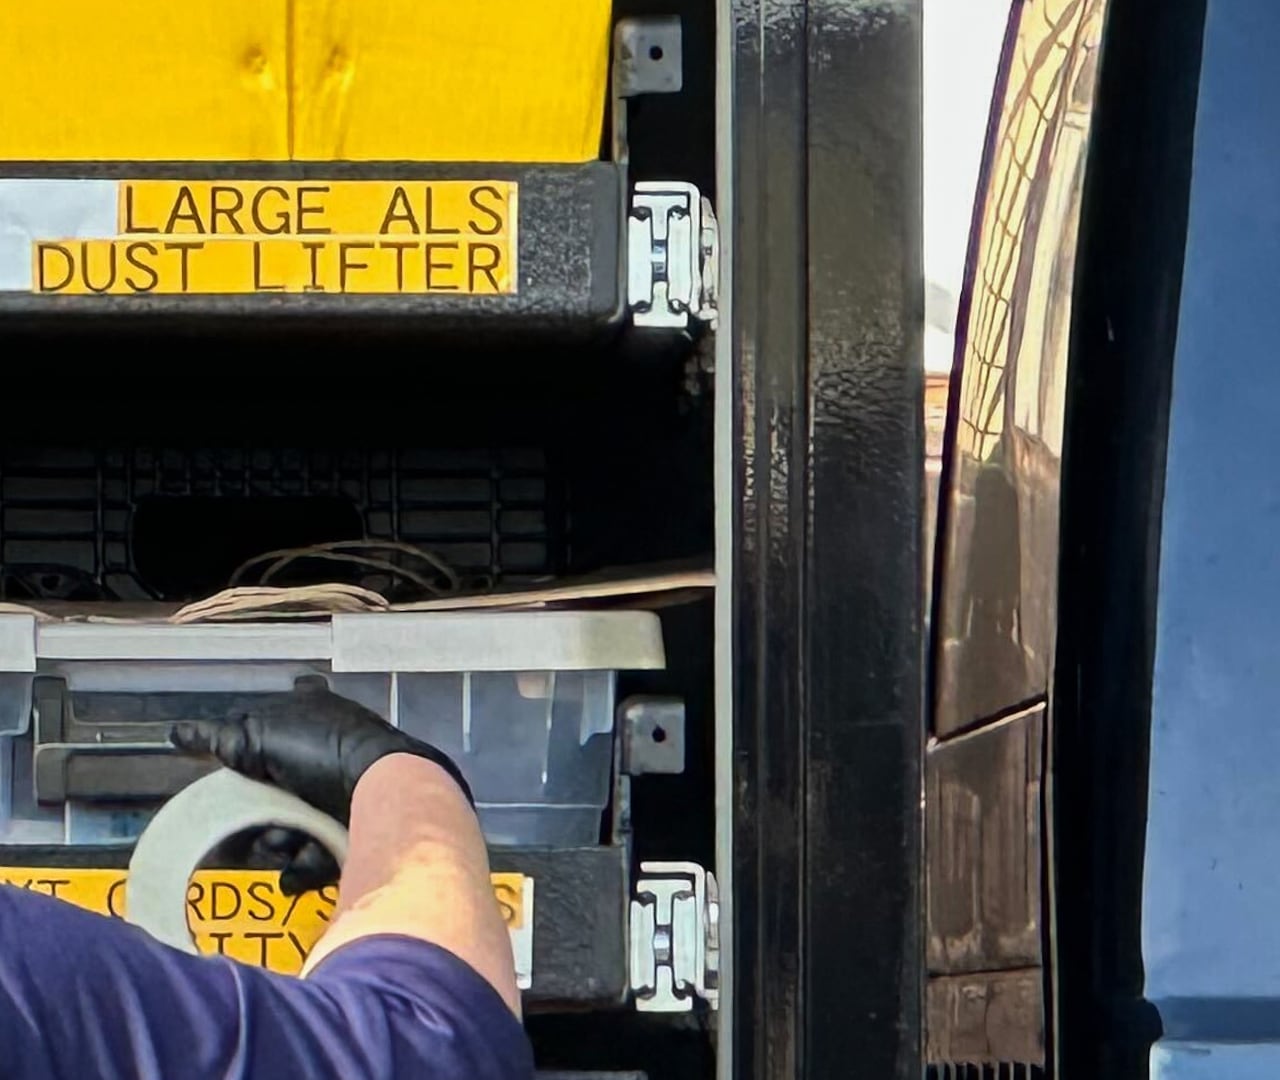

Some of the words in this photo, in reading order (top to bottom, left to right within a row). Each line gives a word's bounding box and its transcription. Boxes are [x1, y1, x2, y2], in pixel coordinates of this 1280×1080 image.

[125, 186, 332, 235] LARGE
[380, 186, 503, 235] ALS
[37, 243, 205, 292] DUST
[253, 243, 501, 291] LIFTER
